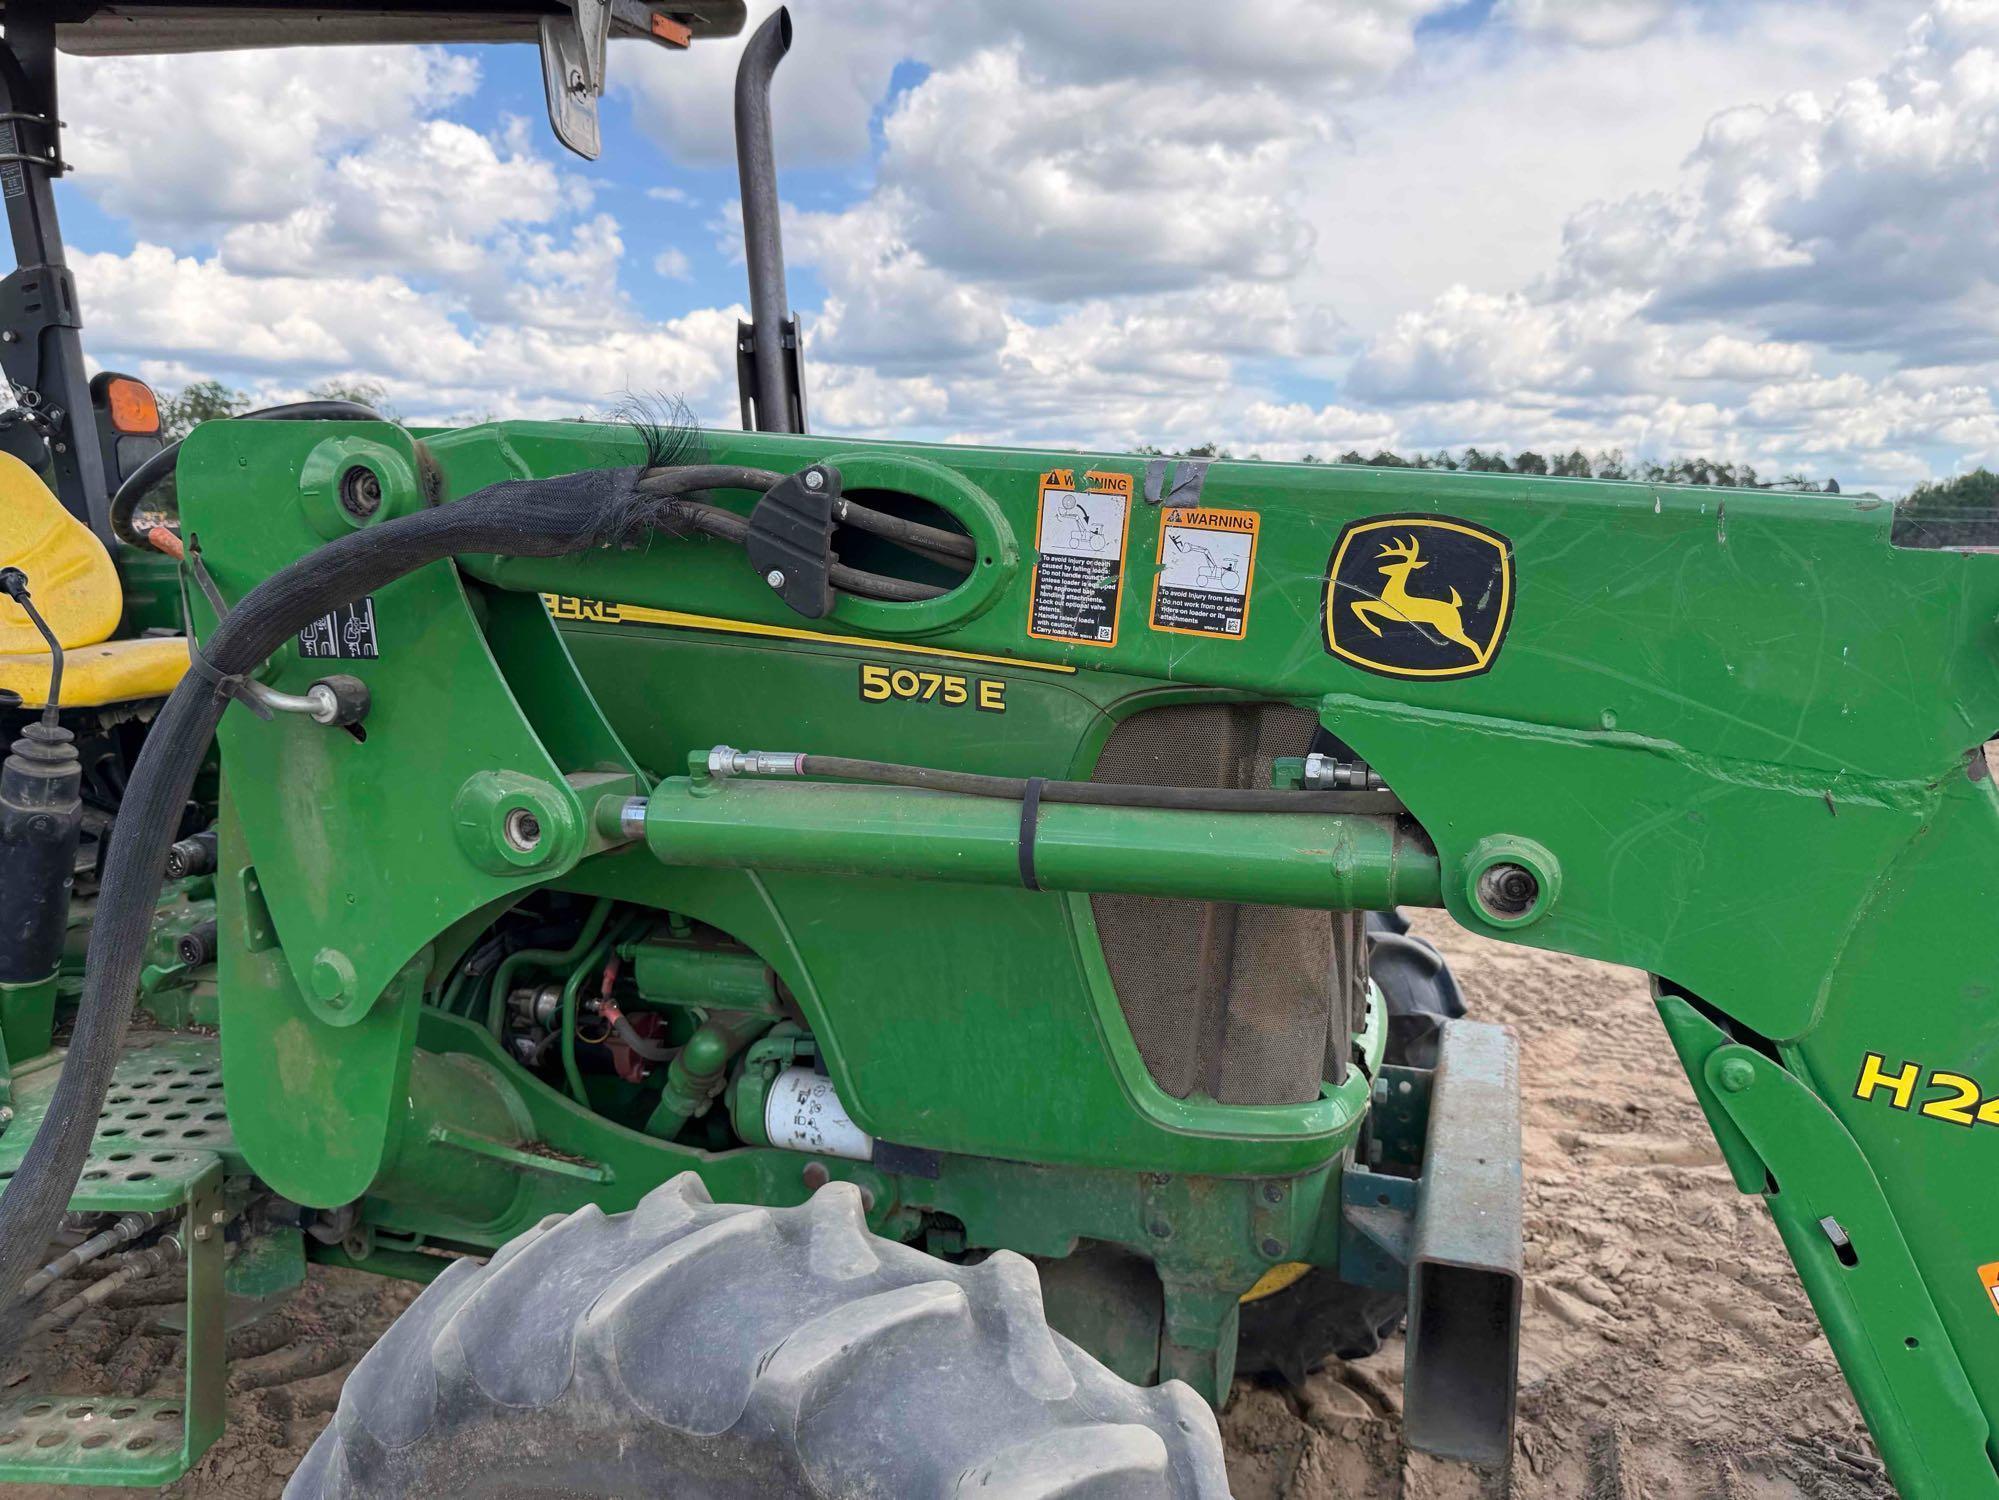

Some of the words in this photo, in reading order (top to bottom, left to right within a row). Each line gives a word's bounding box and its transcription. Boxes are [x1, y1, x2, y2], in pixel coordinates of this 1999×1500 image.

[1186, 513, 1254, 529] WARNING
[1040, 591, 1065, 599] handling
[1189, 592, 1206, 600] injury
[1066, 601, 1089, 609] optional
[1038, 612, 1058, 620] Handle
[1037, 626, 1051, 634] Carry
[862, 664, 968, 705] 5075
[978, 679, 1006, 711] E
